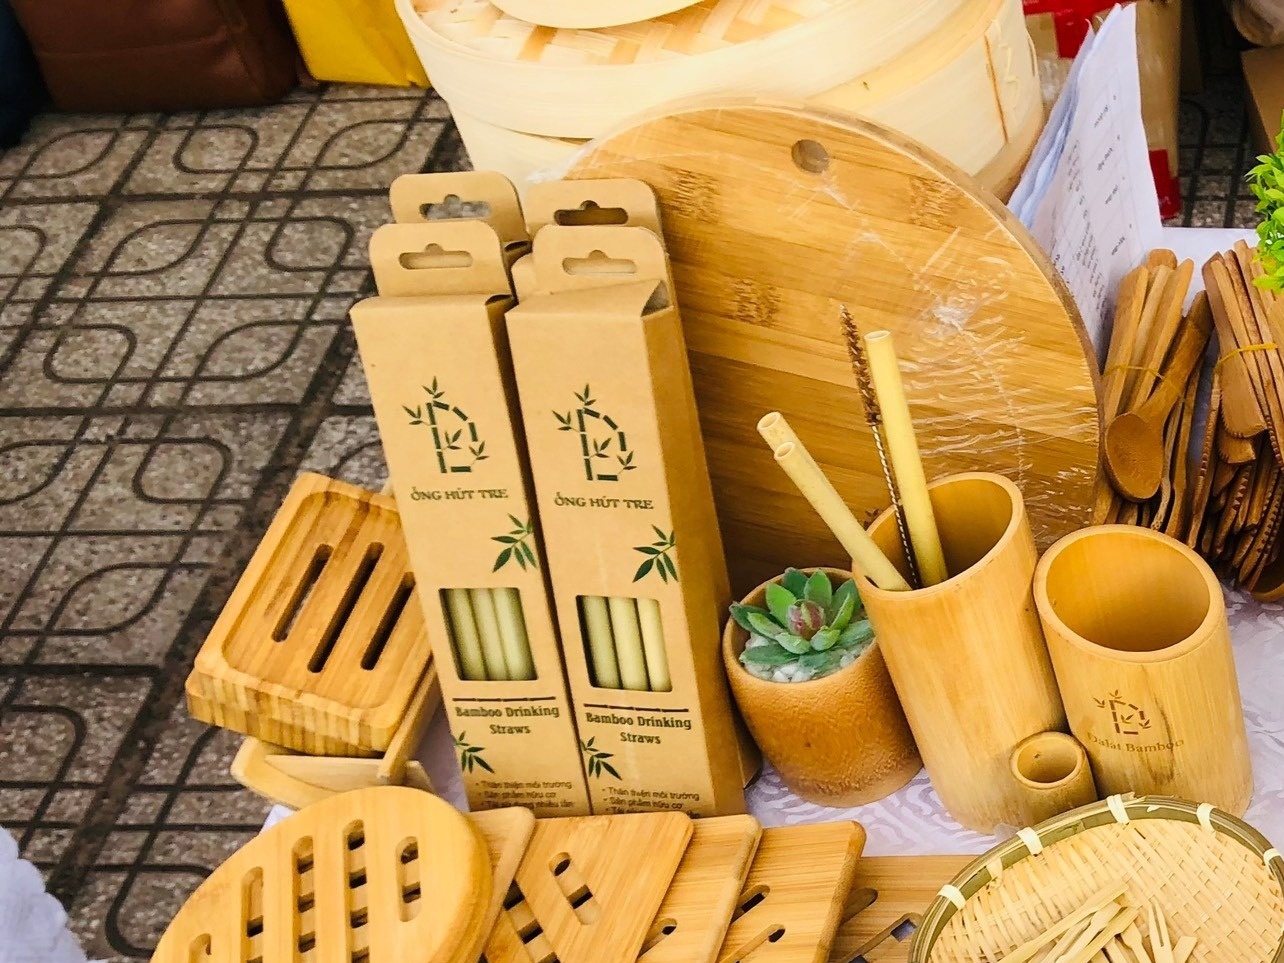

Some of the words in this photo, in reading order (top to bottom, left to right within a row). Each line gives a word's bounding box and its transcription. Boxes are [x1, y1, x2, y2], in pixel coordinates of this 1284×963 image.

[445, 487, 477, 501] HÚT
[479, 487, 509, 500] TRE
[590, 496, 621, 509] HÚT
[623, 498, 654, 510] TRE
[455, 706, 502, 717] Bamboo
[505, 705, 560, 718] Drinking
[585, 712, 633, 726] Bamboo
[637, 716, 692, 730] Drinking
[489, 724, 531, 735] Straws
[619, 732, 662, 745] Straws
[1086, 731, 1122, 750] Dalat
[1125, 738, 1185, 753] Bamboo
